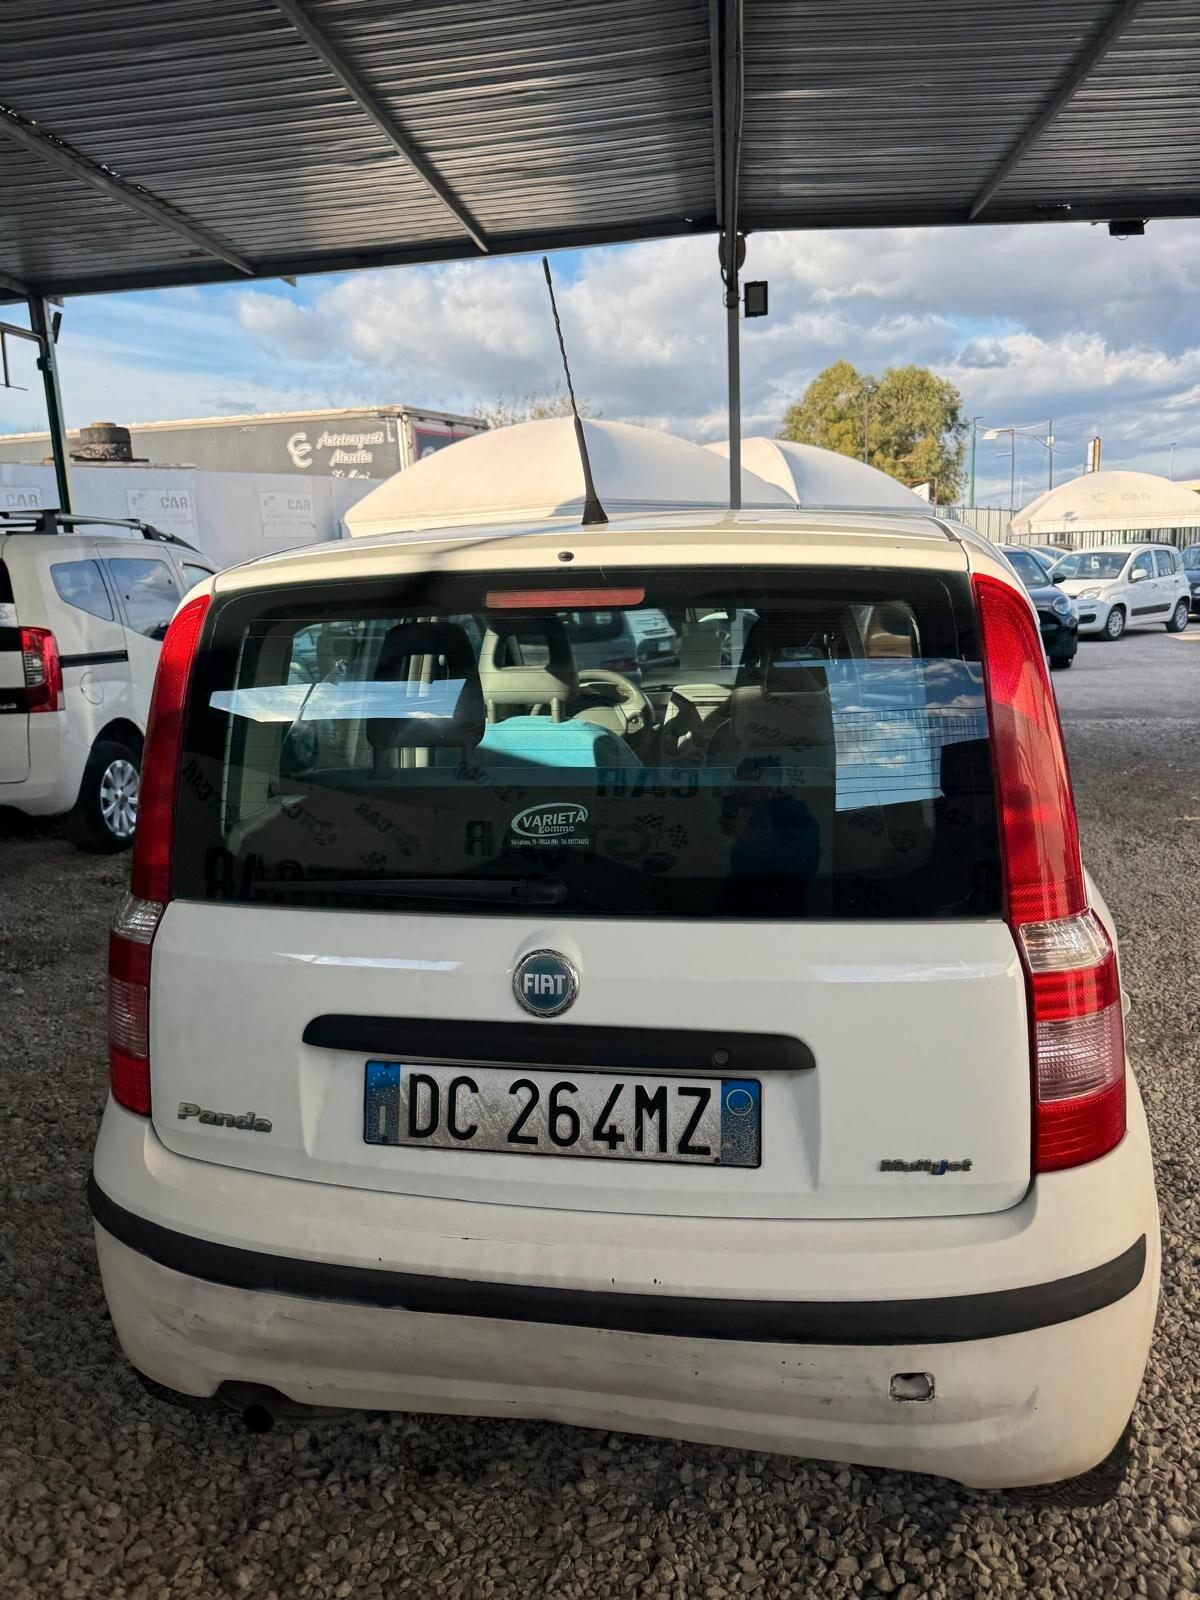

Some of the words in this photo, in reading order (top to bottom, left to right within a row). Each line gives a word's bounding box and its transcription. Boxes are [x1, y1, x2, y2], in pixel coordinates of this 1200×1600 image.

[6, 494, 39, 507] CAR
[160, 496, 188, 509] CAR
[287, 498, 311, 511] CAR
[538, 824, 575, 834] gomme
[523, 973, 566, 995] FIAT
[177, 1101, 273, 1133] Panda
[408, 1073, 479, 1141] DC
[507, 1077, 712, 1156] 264MZ
